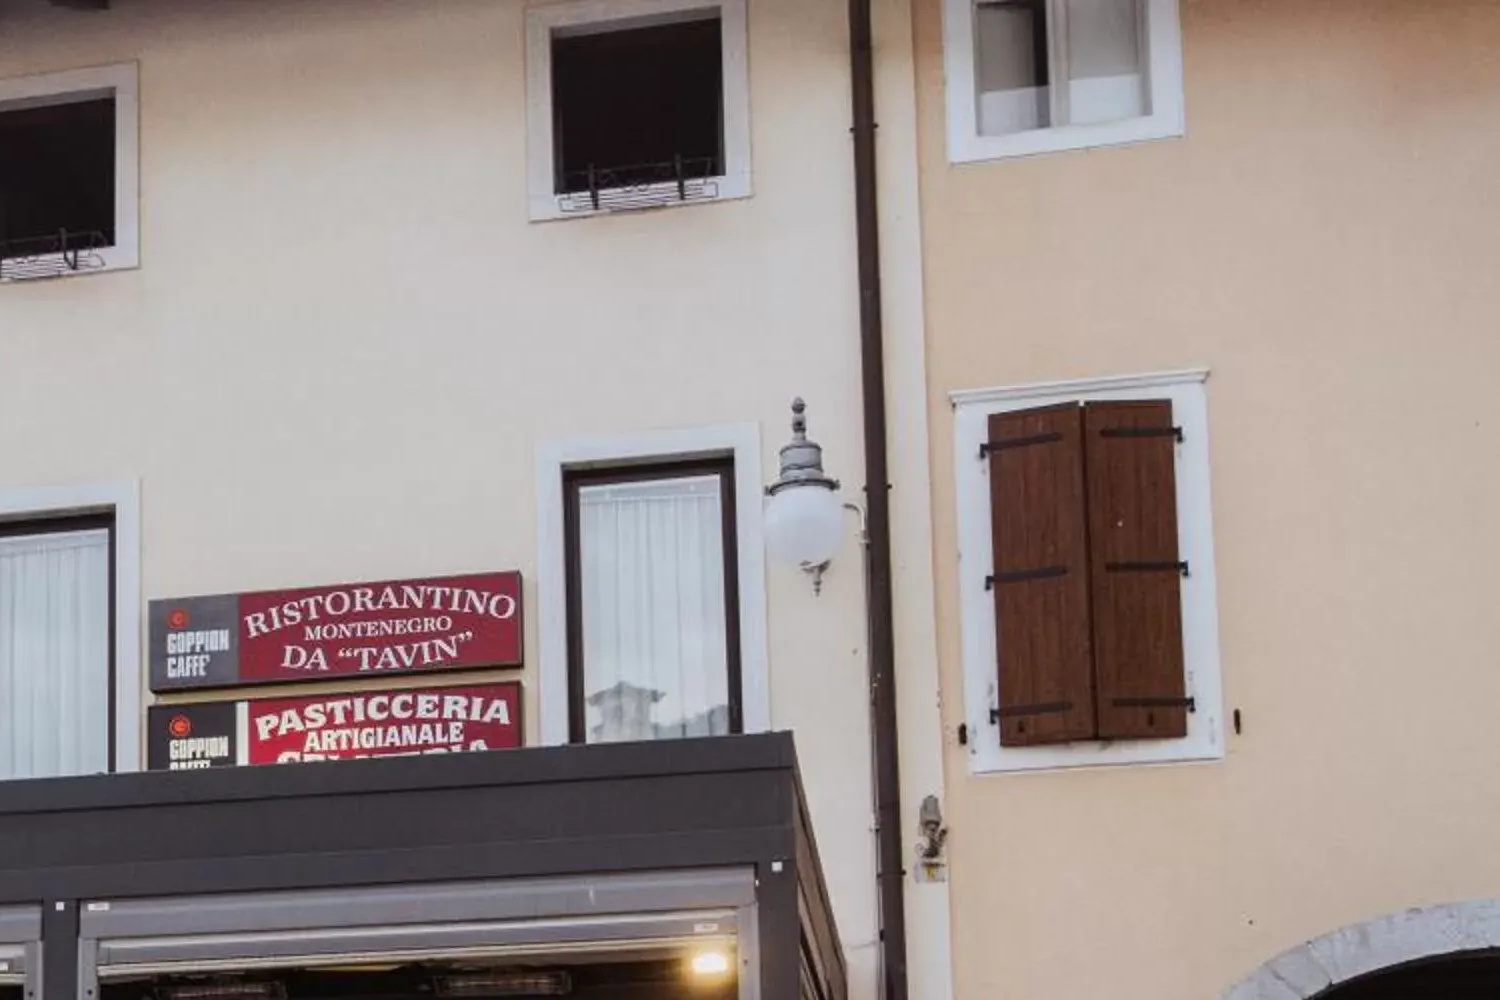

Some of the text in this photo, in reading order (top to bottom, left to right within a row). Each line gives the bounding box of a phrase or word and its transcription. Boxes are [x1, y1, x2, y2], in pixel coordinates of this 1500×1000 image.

[245, 585, 516, 638] RISTORANTINO
[304, 615, 452, 641] MONTENEGRO
[167, 629, 230, 654] GOPPION
[281, 645, 329, 670] DA
[255, 694, 511, 741] PASTICCERIA
[169, 736, 229, 760] GOPPION
[303, 722, 465, 753] ARTIGIANALE
